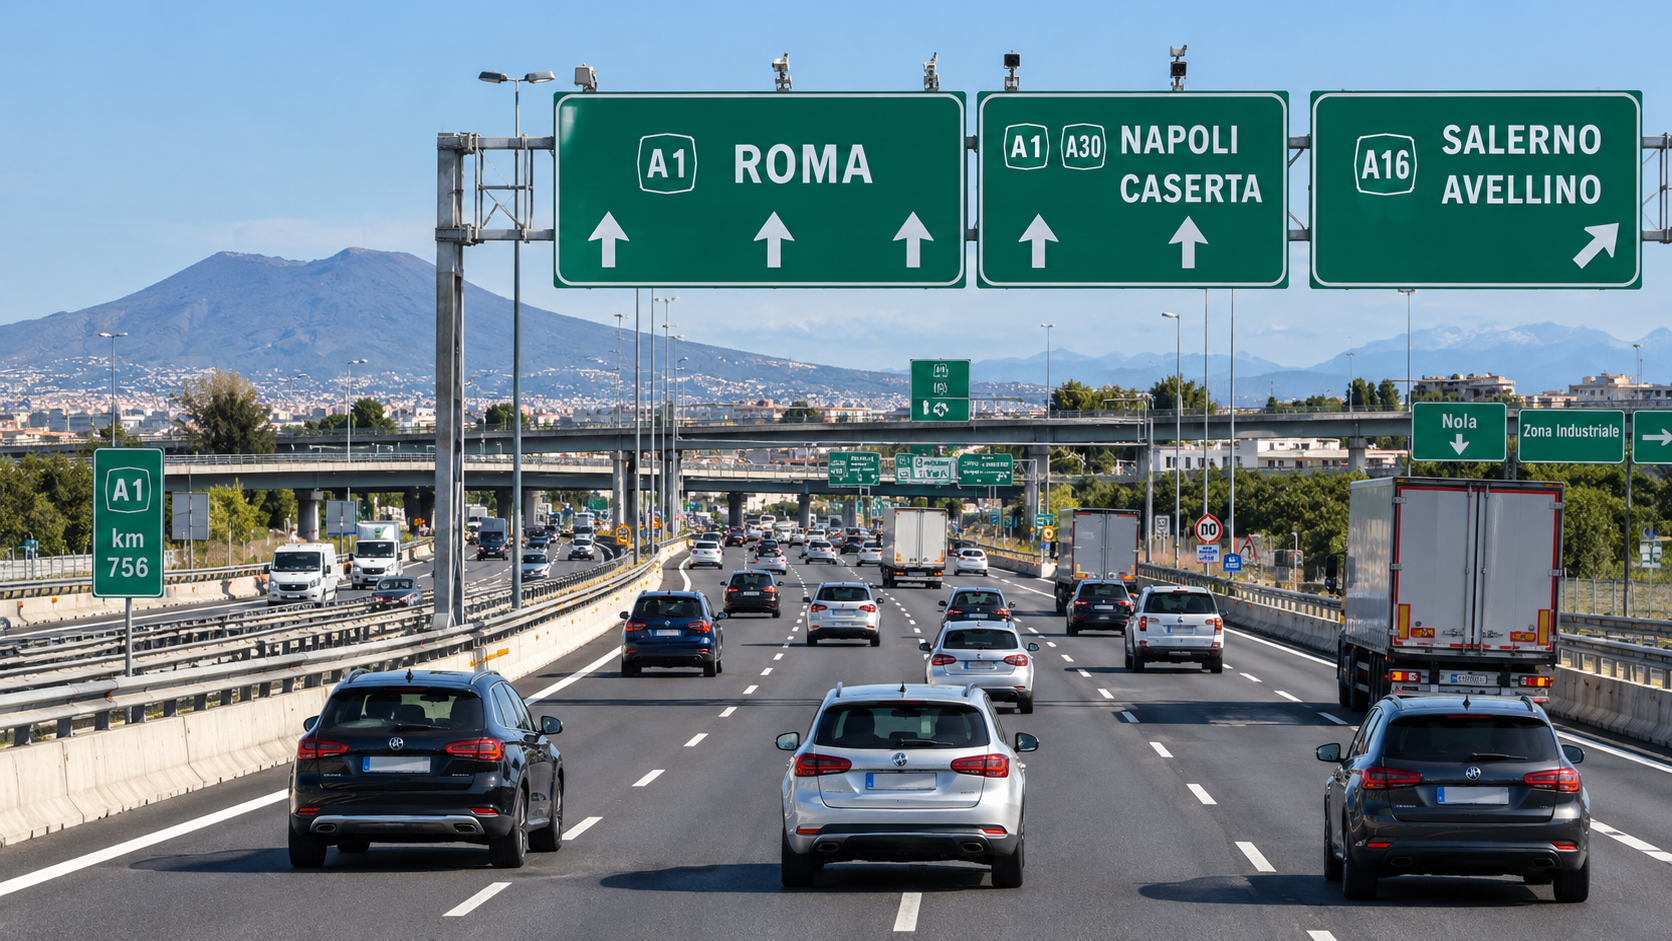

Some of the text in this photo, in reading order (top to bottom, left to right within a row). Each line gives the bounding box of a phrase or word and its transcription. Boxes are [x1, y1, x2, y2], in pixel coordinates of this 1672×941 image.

[1011, 124, 1238, 159] A1 A30 NAPOLI
[1441, 124, 1602, 155] SALERNO
[647, 143, 873, 184] A1 ROMA
[1361, 148, 1410, 180] A16
[1120, 173, 1263, 204] CASERTA
[1441, 174, 1602, 205] AVELLINO
[1442, 413, 1477, 429] Nola
[1523, 423, 1620, 438] Zona Industriale
[112, 478, 142, 502] A1
[112, 527, 144, 548] km
[107, 556, 149, 578] 756
